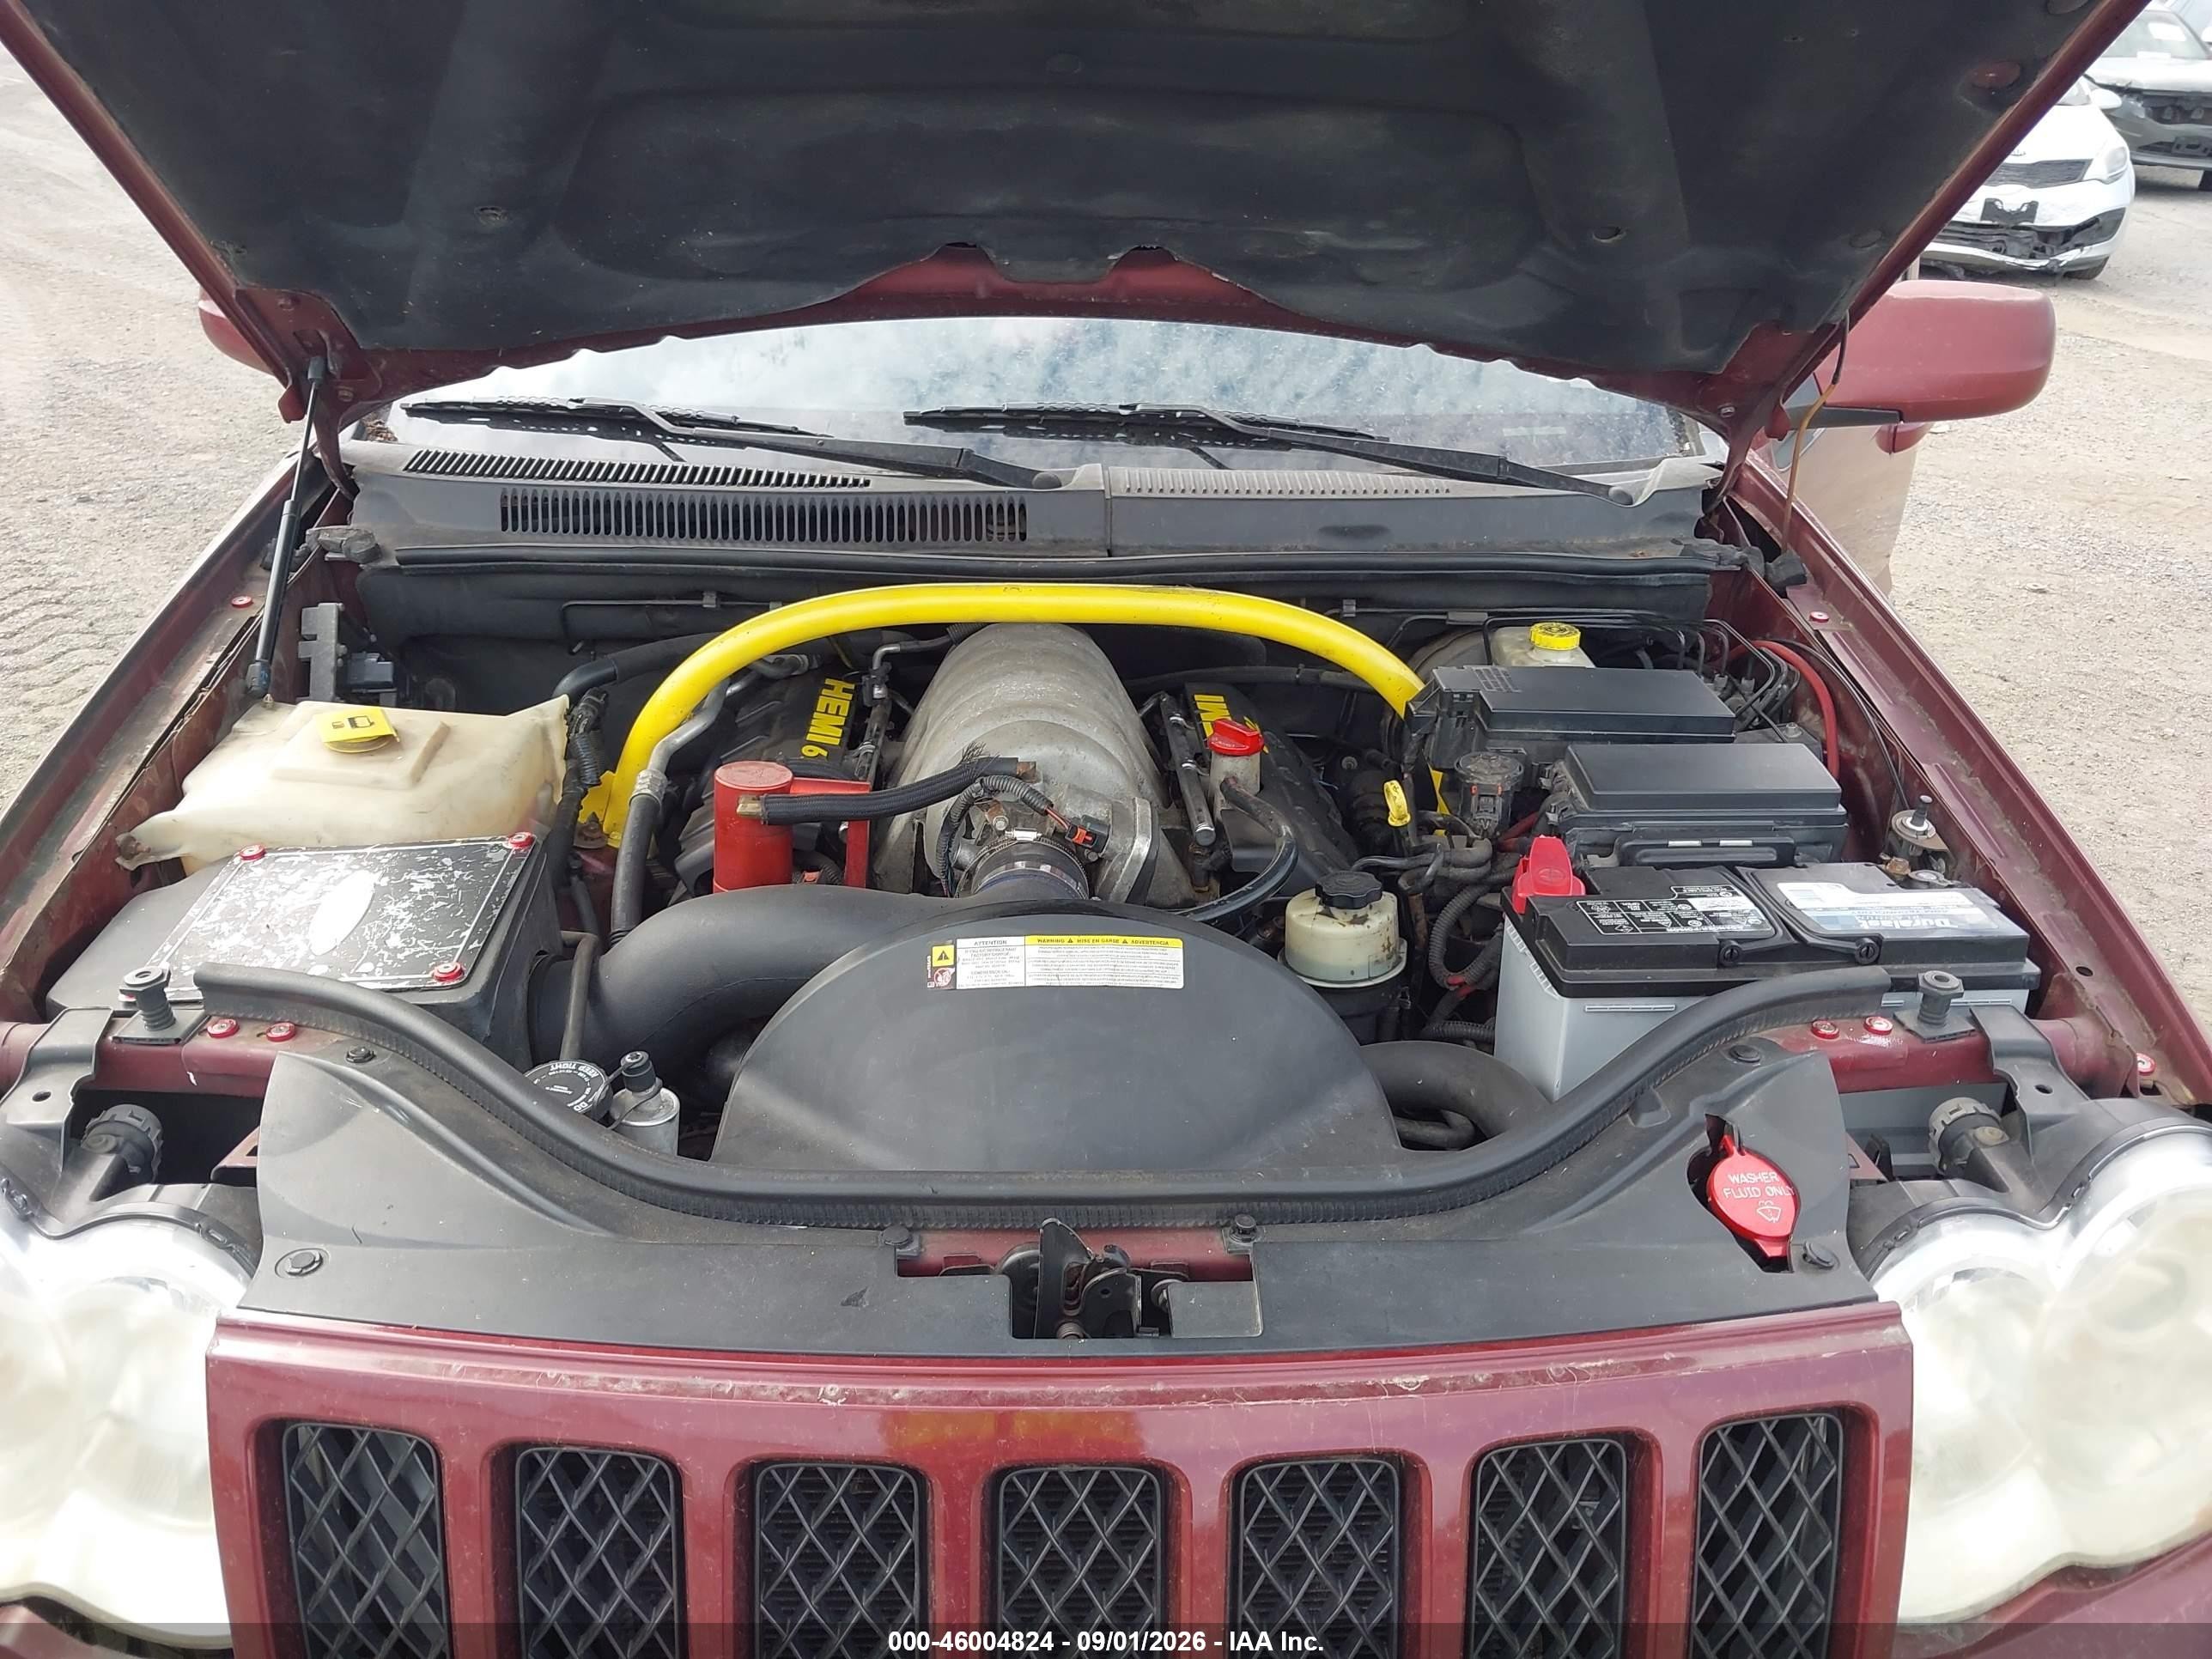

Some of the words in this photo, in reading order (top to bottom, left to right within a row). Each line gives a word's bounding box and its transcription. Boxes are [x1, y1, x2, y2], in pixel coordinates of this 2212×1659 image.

[805, 678, 855, 746] HEMI
[550, 1062, 577, 1072] TIGHT
[578, 1065, 599, 1079] KEEP
[1728, 1171, 1780, 1184] WASHER
[1723, 1187, 1761, 1199] FLUID
[1765, 1186, 1795, 1197] ONLY
